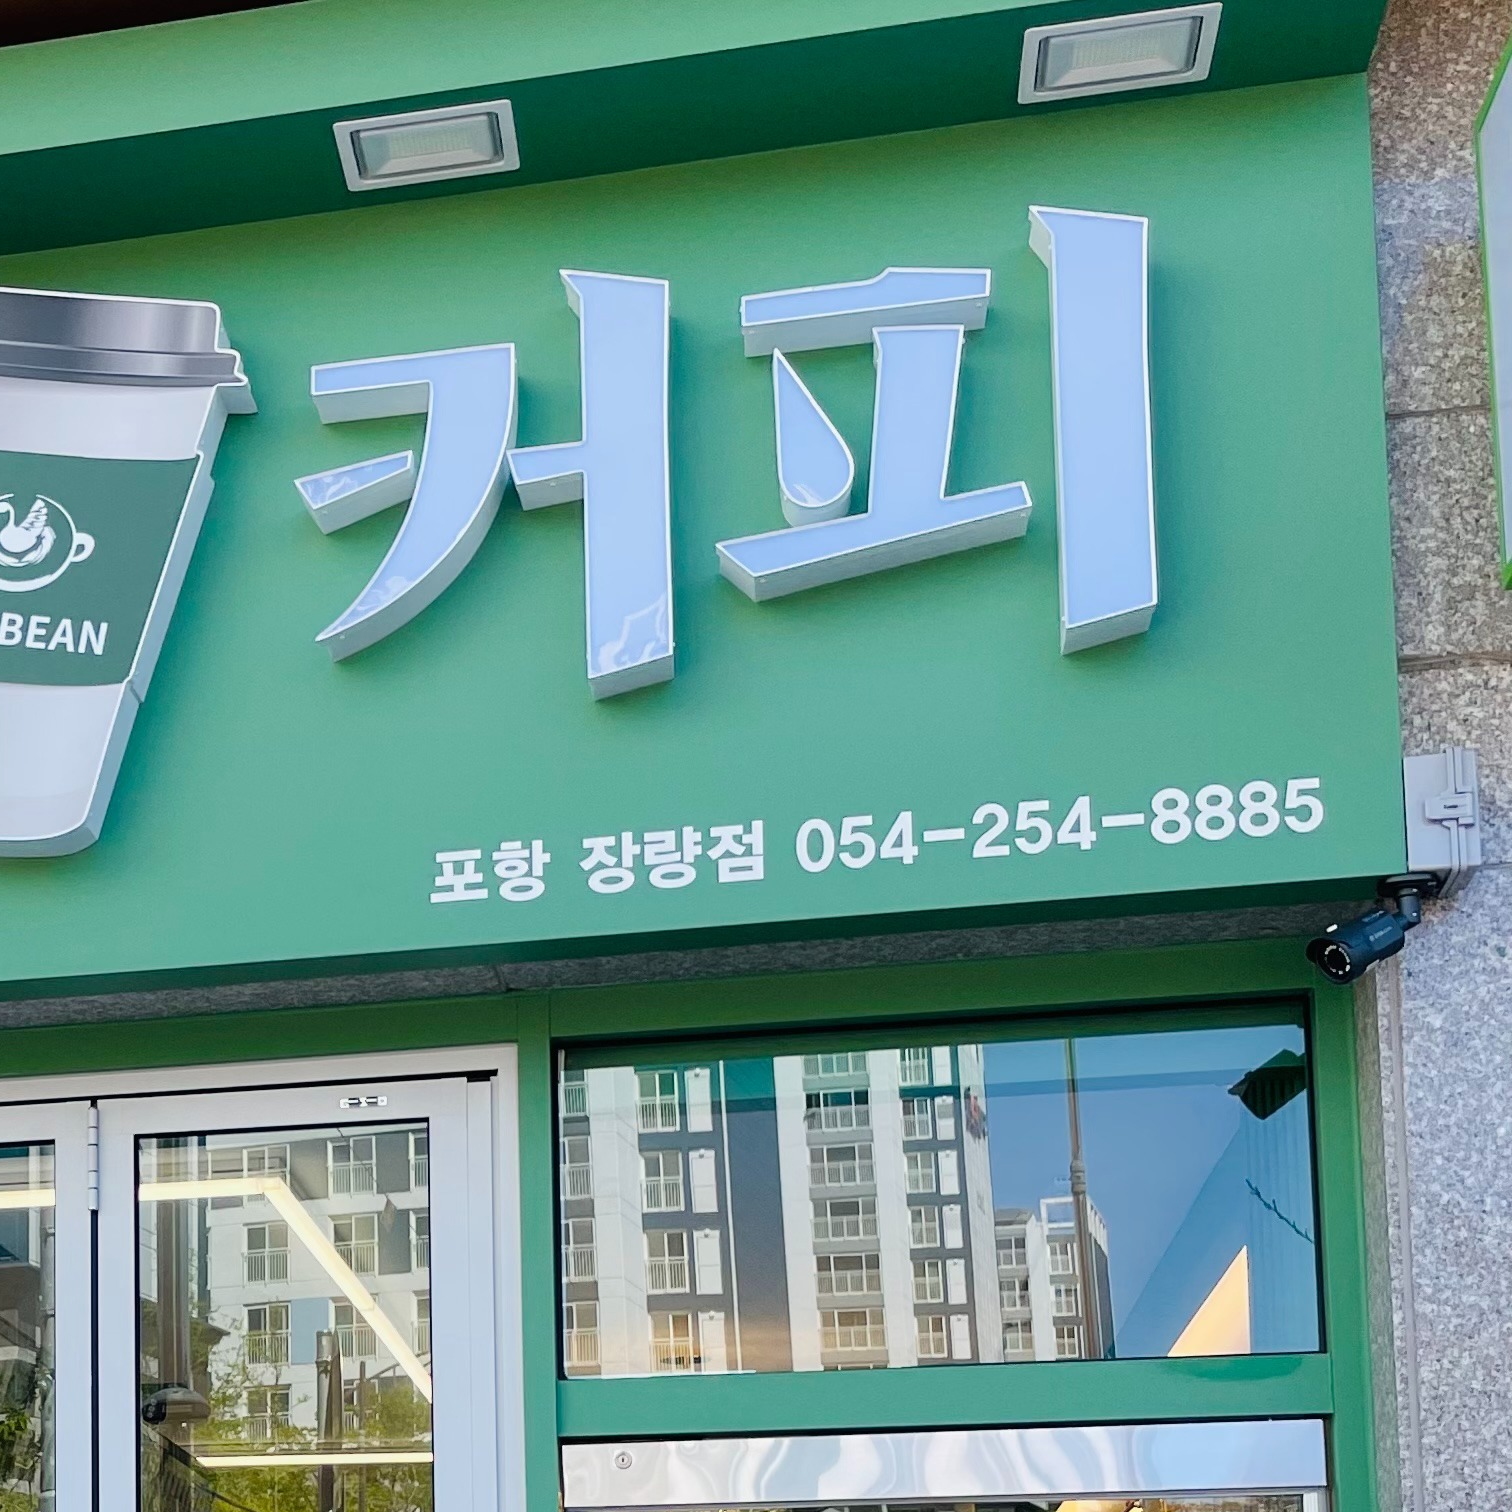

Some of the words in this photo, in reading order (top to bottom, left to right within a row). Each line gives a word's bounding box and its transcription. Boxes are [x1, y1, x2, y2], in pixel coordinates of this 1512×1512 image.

[294, 205, 1158, 700] 커피
[428, 839, 551, 904] 포항
[579, 819, 766, 894] 장량점
[795, 777, 1325, 874] 054-254-8885
